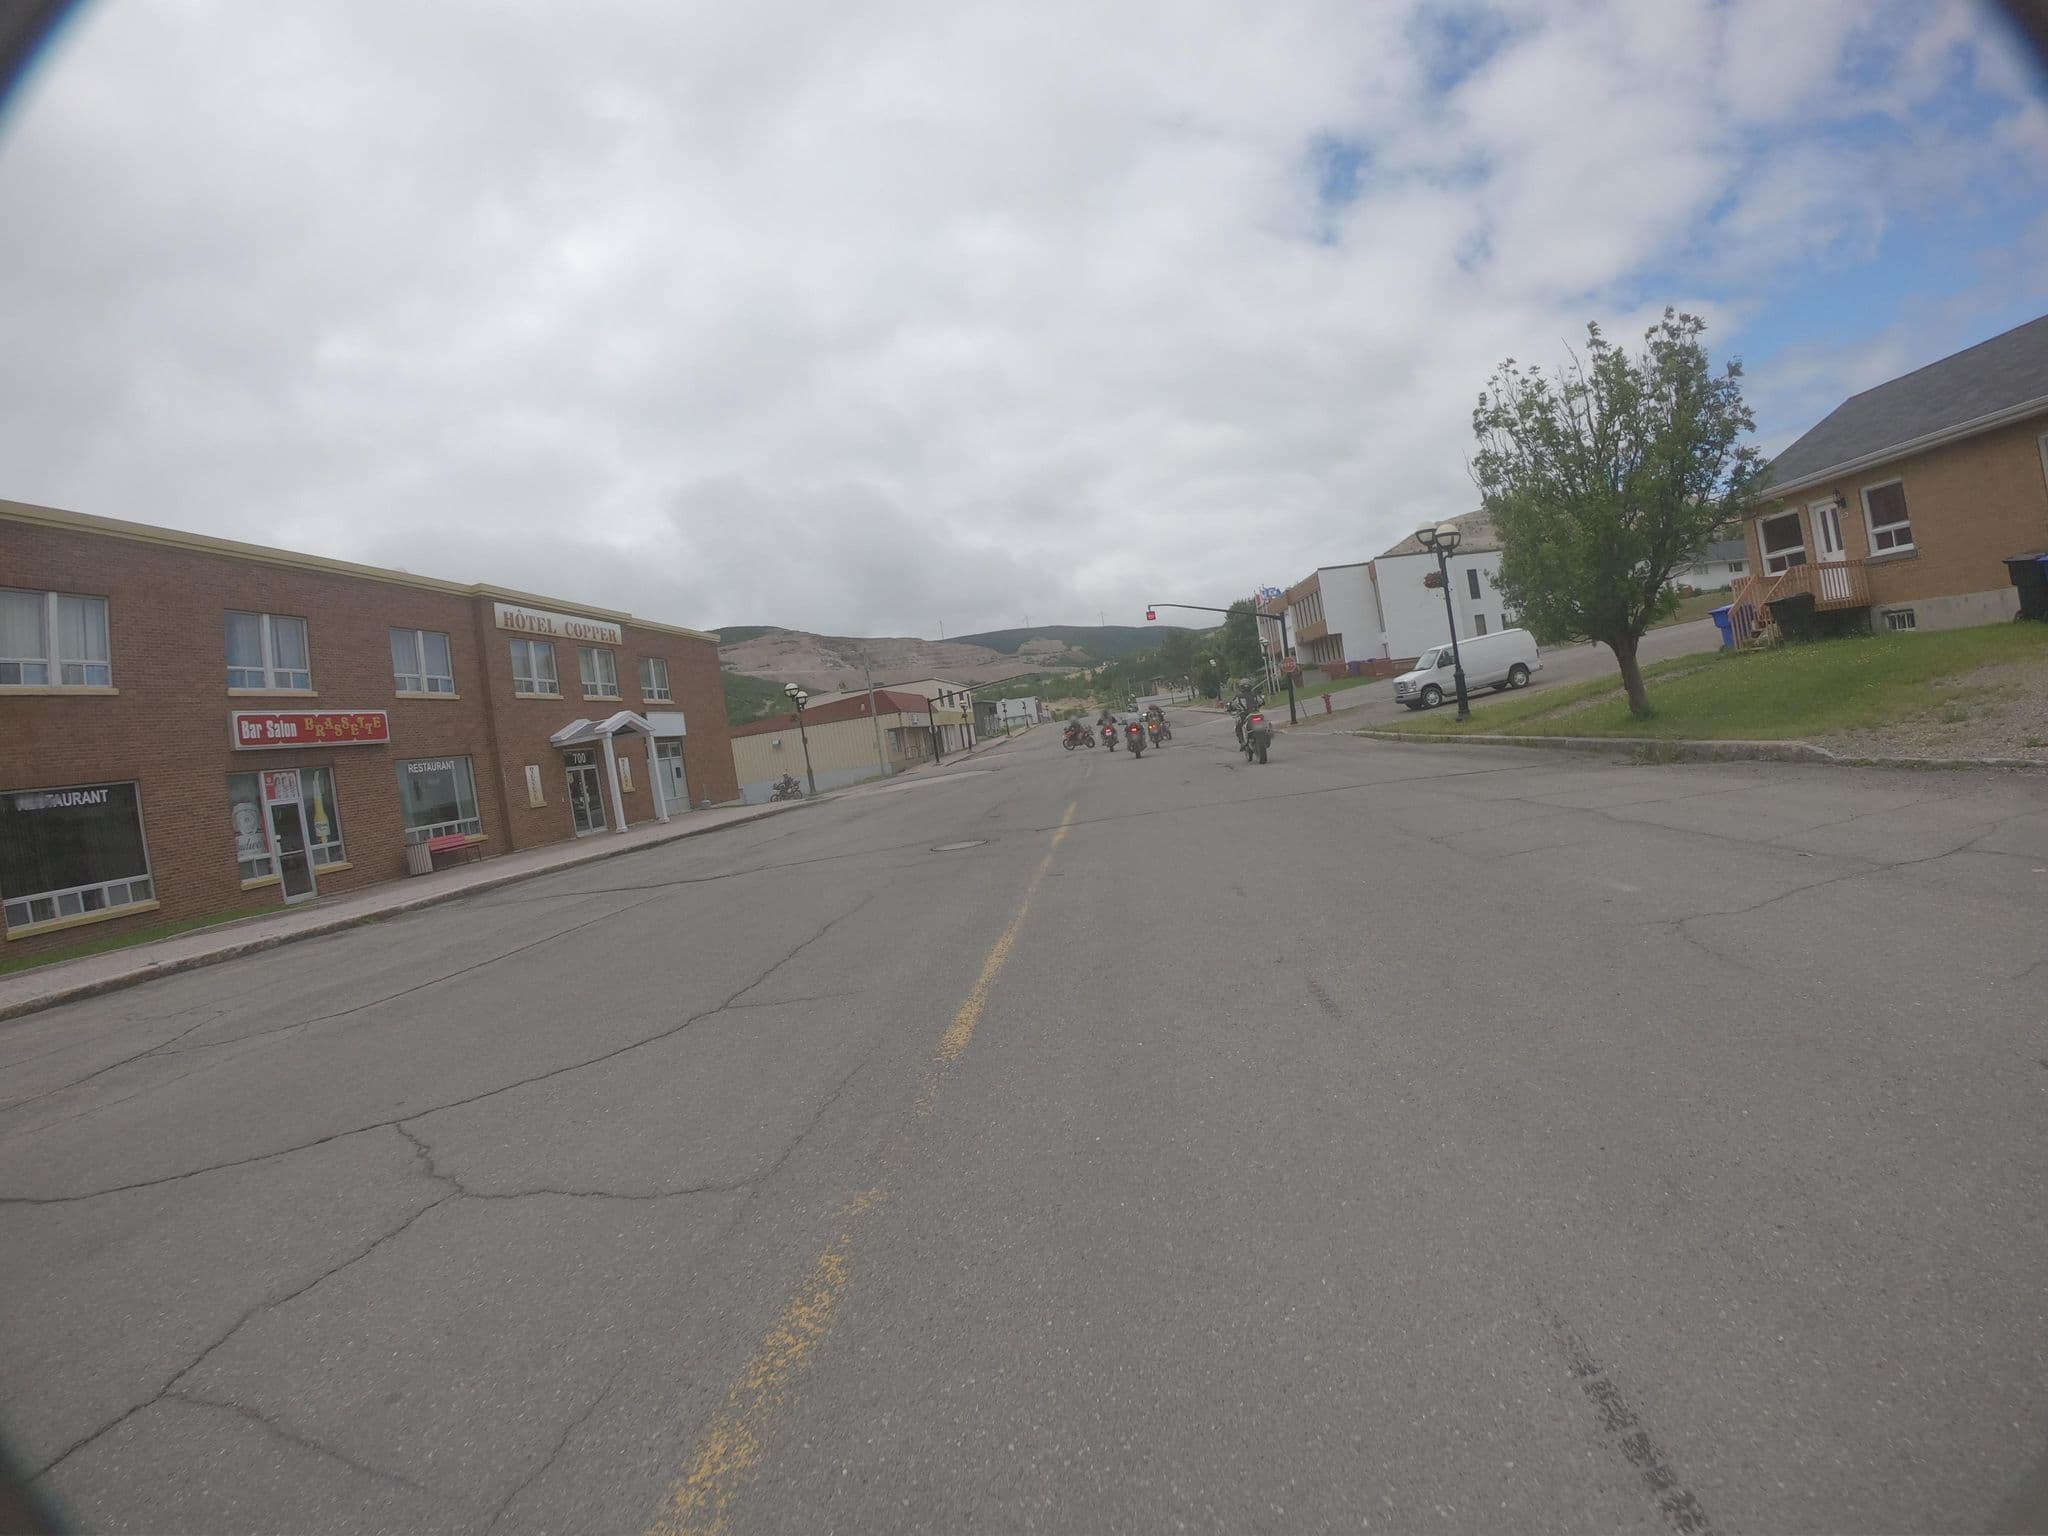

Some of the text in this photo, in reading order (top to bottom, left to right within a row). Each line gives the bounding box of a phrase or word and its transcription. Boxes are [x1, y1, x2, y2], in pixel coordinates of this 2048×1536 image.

[503, 609, 617, 642] HÔTEL COPPER
[241, 720, 262, 739] Bar
[266, 720, 297, 738] Salon
[408, 760, 455, 773] RESTAURANT
[15, 789, 108, 811] TAURANT
